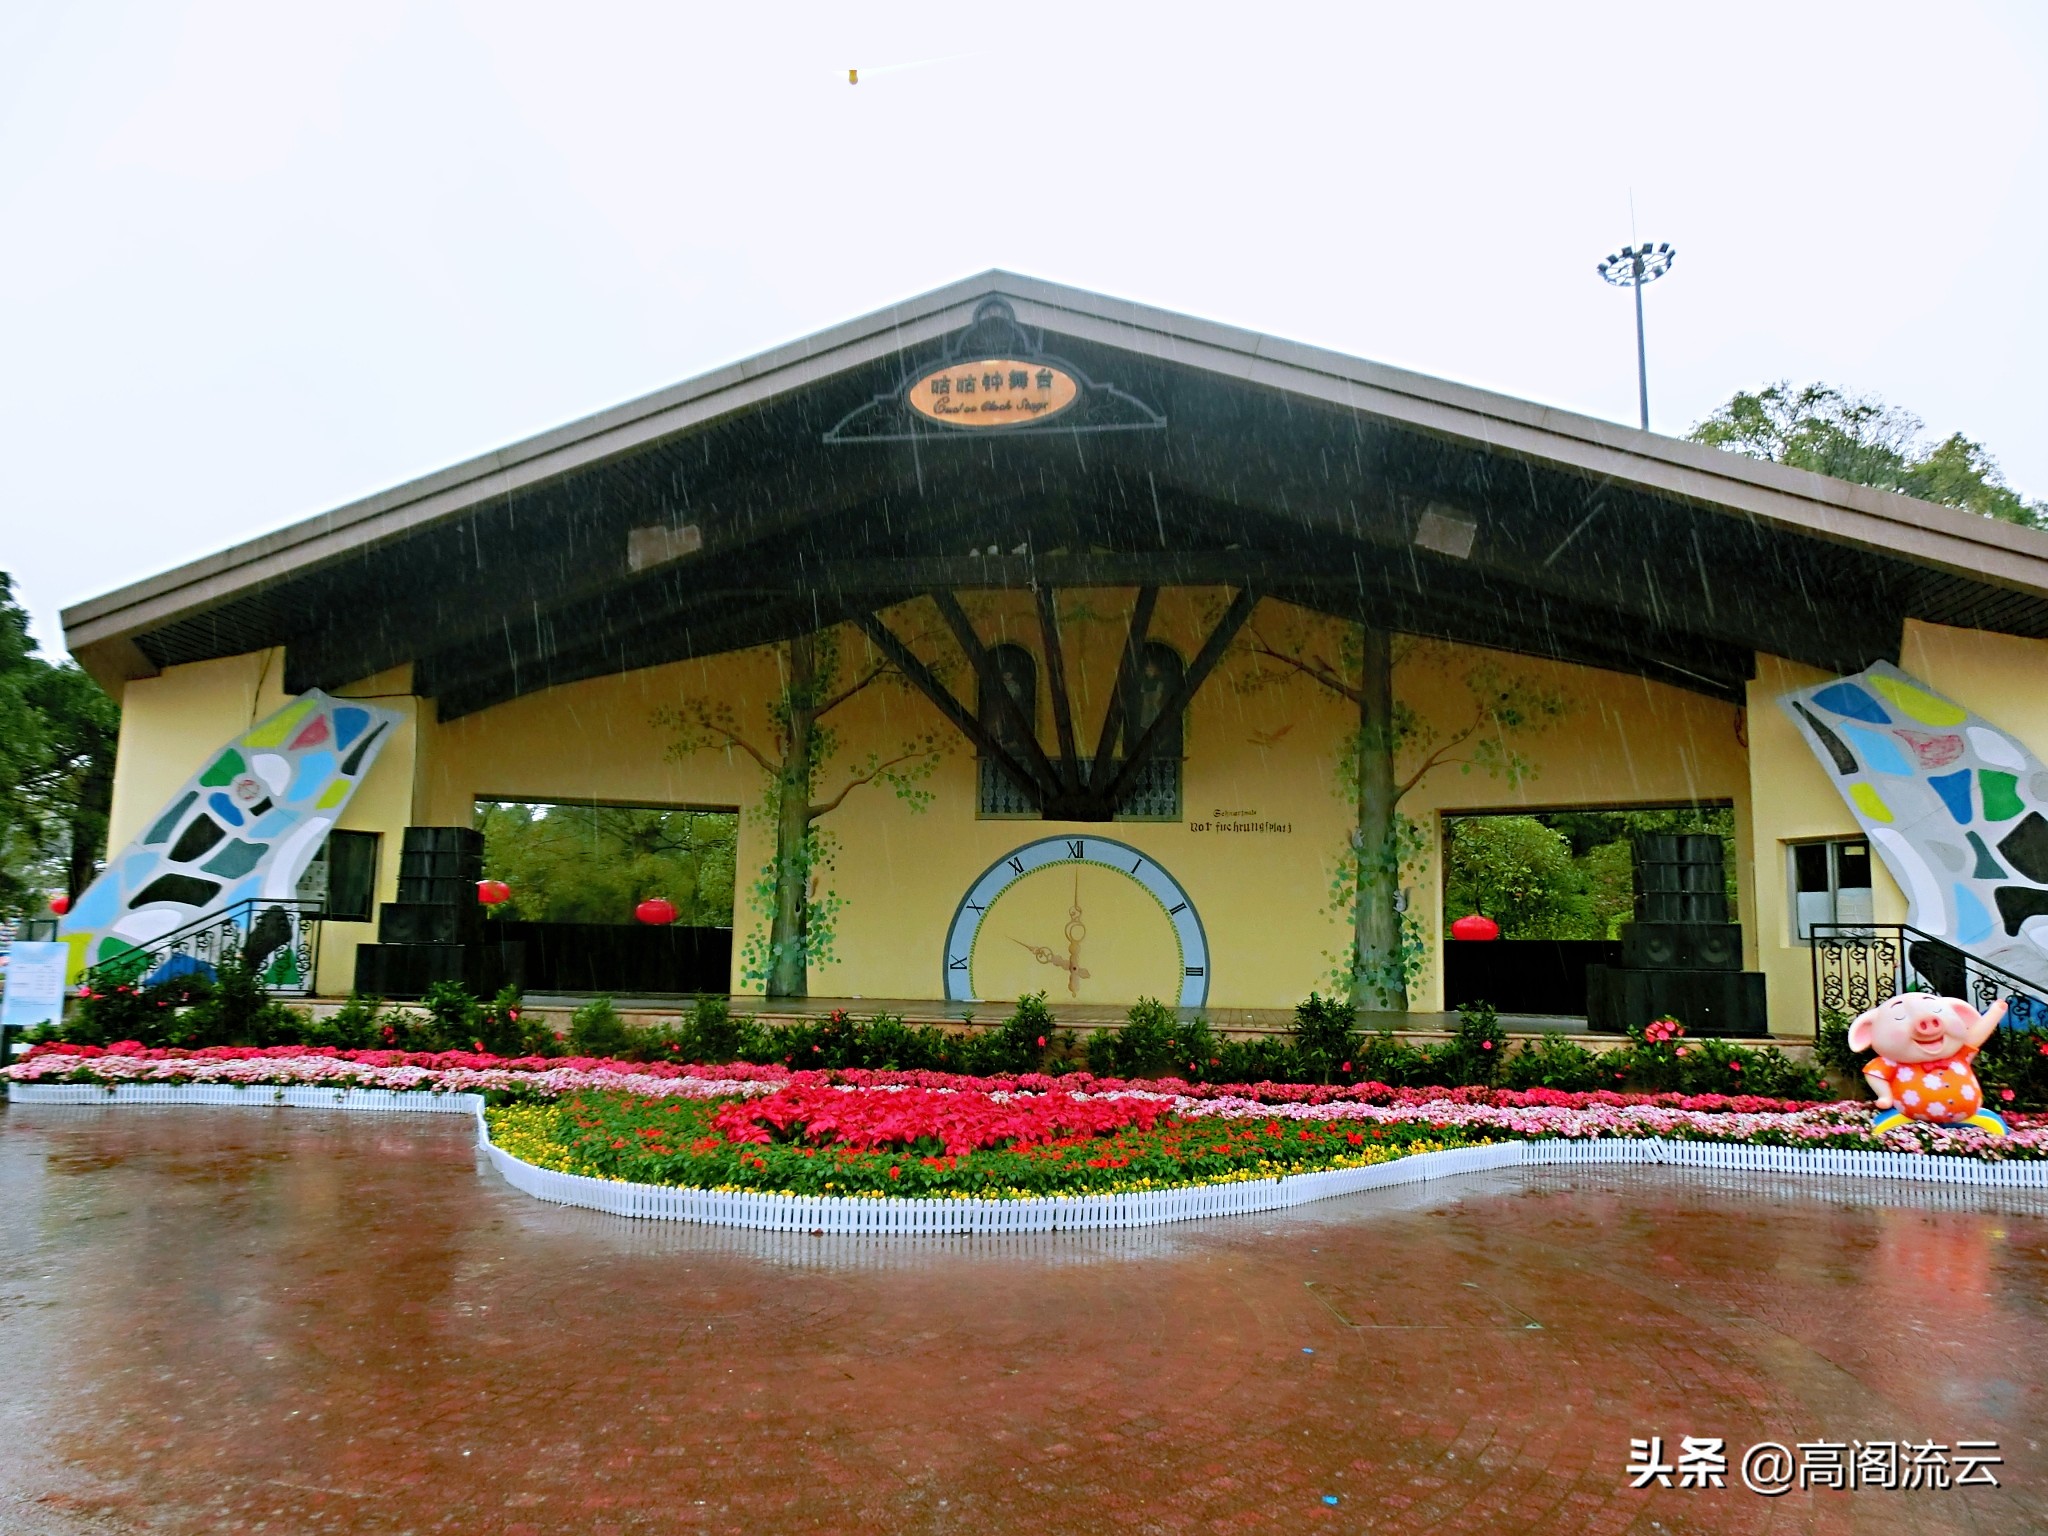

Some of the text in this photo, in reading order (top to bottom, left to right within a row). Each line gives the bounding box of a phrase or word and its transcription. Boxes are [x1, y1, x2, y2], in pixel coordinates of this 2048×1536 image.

[1067, 840, 1084, 859] XII
[1007, 856, 1025, 876] XI
[1130, 858, 1143, 875] I
[966, 899, 985, 916] X
[1169, 902, 1187, 916] II
[949, 954, 968, 970] IX
[1185, 966, 1203, 977] III
